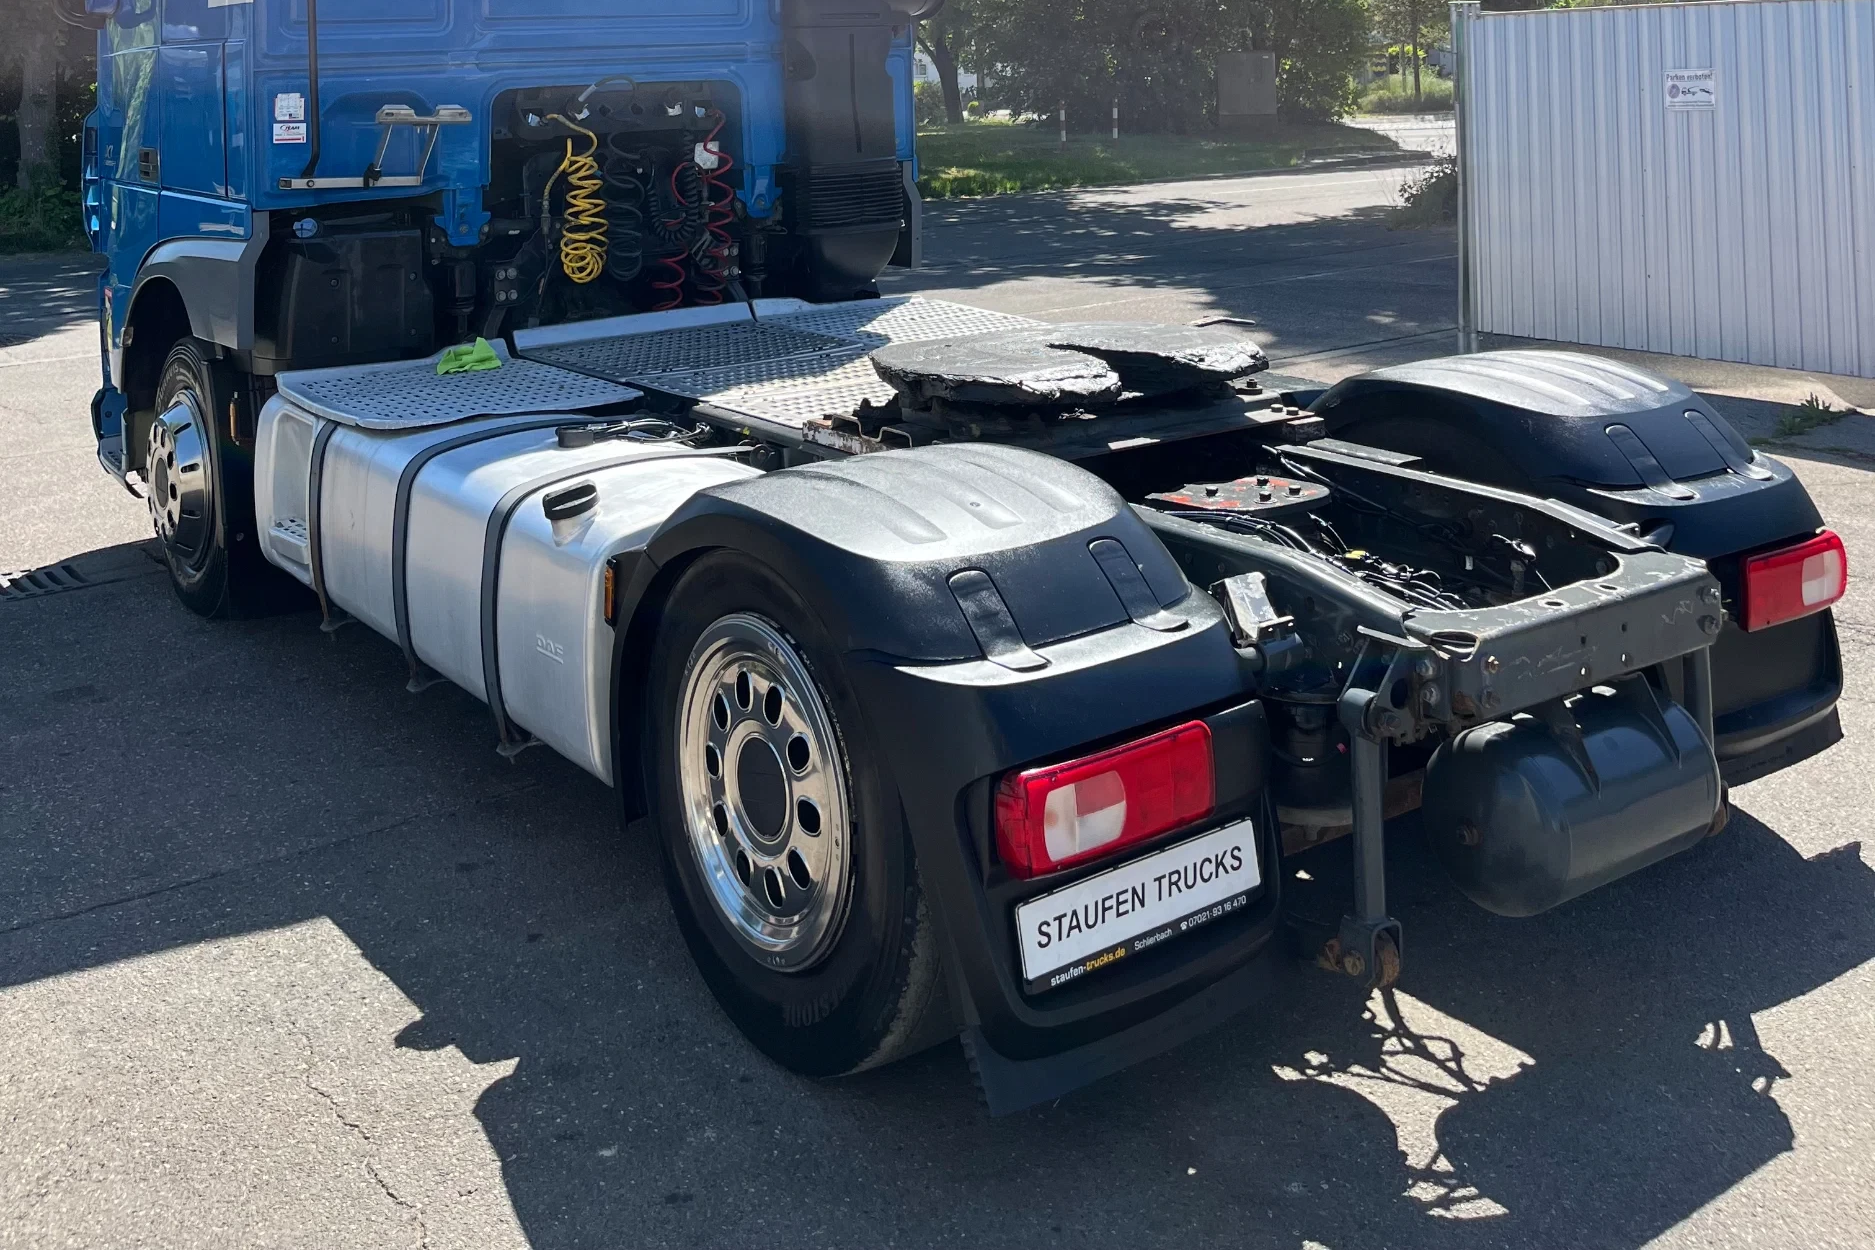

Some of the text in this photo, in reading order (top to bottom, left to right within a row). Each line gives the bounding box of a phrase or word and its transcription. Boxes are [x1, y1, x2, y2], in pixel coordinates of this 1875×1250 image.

[1666, 73, 1686, 81] Parken
[1037, 845, 1243, 949] STAUFEN TRUCKS
[1050, 947, 1126, 987] staufen-trucks.de
[1134, 928, 1173, 951] Schlierbach
[1224, 901, 1232, 911] 16
[1233, 895, 1247, 907] 470
